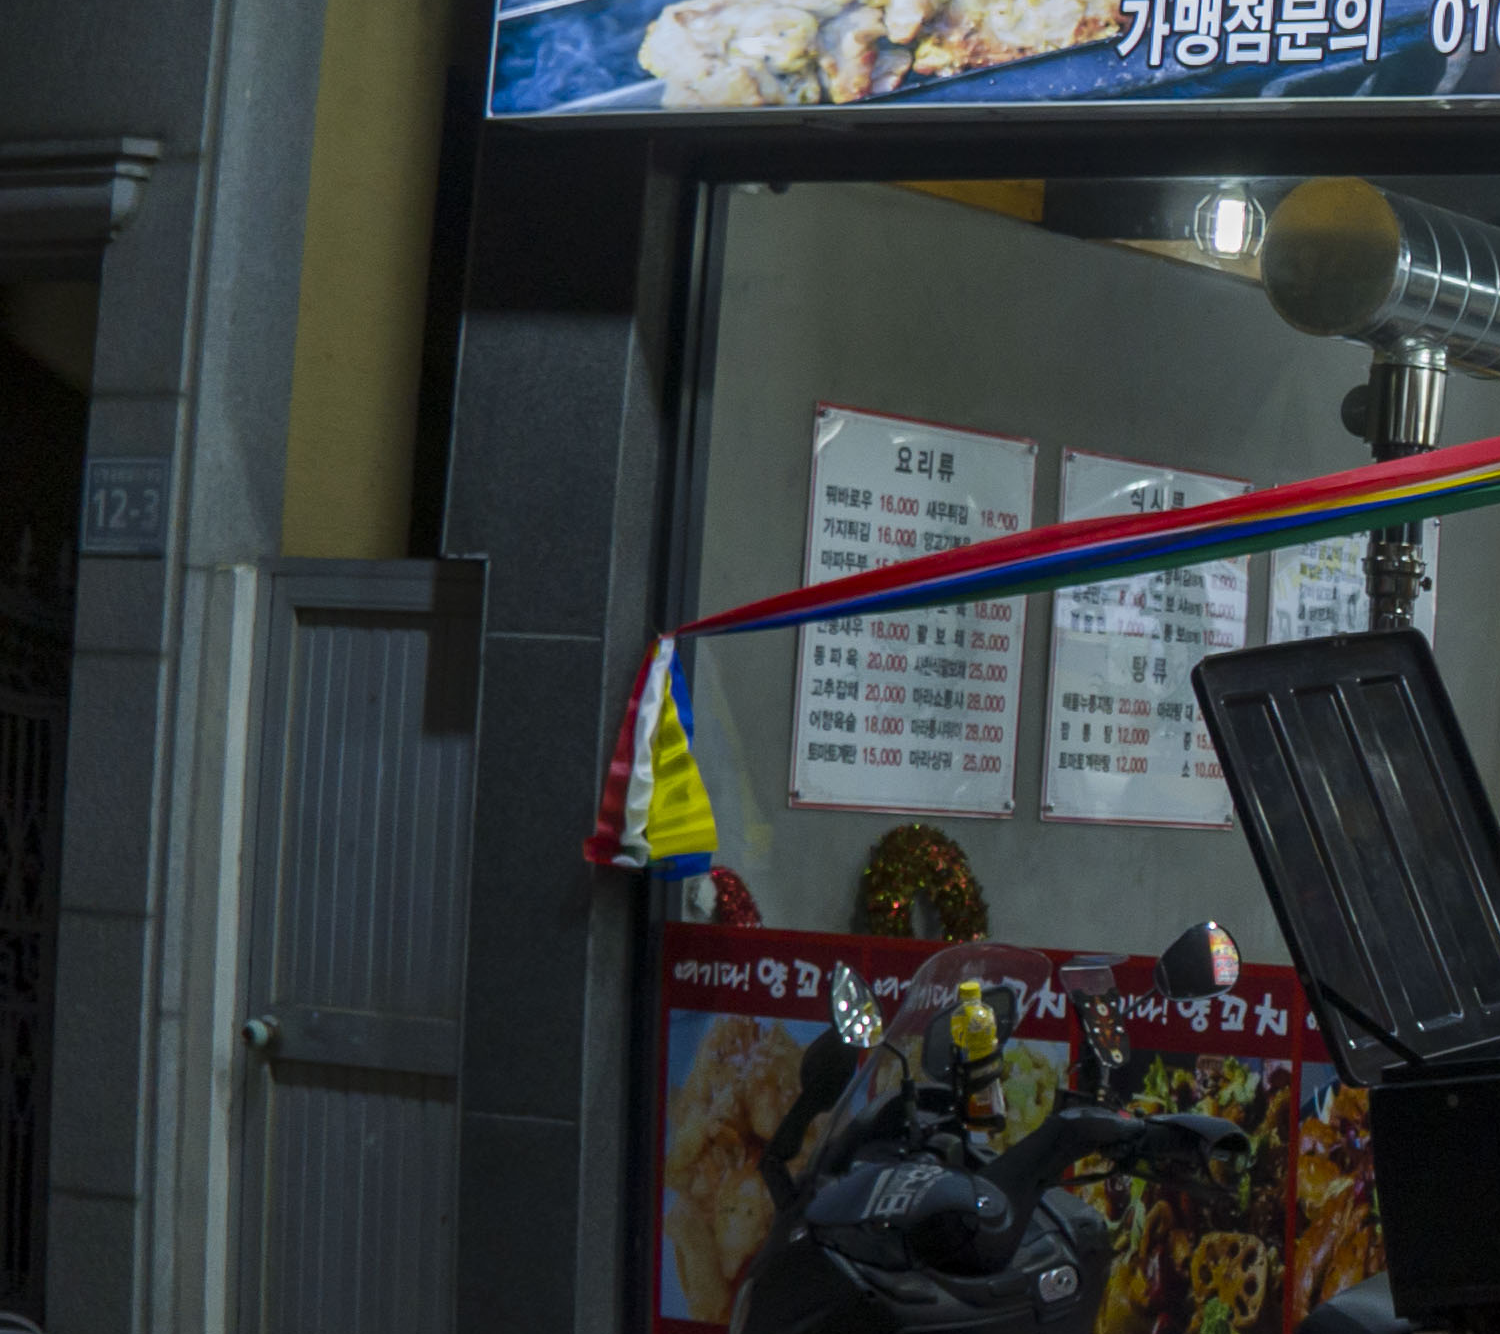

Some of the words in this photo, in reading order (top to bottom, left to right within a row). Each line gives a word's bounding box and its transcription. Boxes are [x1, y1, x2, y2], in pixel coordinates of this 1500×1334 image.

[880, 494, 920, 517] 16,000
[878, 526, 917, 548] 16,000
[870, 621, 910, 642] 18,000
[971, 631, 1010, 653] 25,000
[867, 652, 908, 673] 20,000
[969, 662, 1008, 683] 25,000
[865, 684, 906, 705] 20,000
[1118, 697, 1151, 717] 20,000
[864, 715, 904, 736] 18,000
[863, 747, 903, 768] 15,000
[963, 753, 1001, 774] 25,000
[756, 956, 838, 999] 양꼬
[1176, 992, 1288, 1037] 양꼬치
